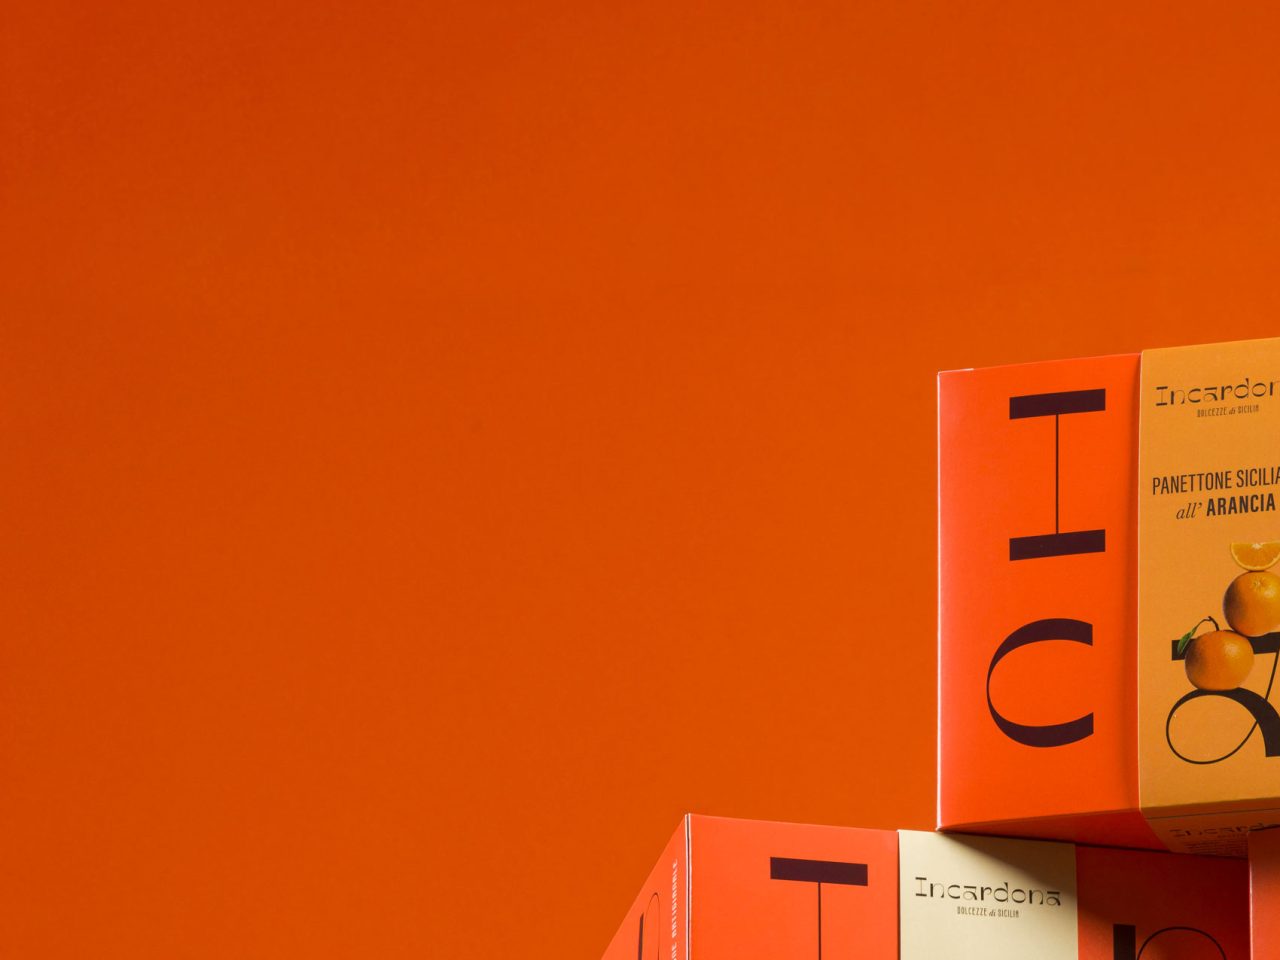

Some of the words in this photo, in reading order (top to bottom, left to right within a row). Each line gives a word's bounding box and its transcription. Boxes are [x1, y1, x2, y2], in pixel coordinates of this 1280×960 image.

[1197, 407, 1227, 417] DOLCEZZE
[1238, 404, 1259, 414] SICILIA
[1152, 471, 1232, 495] PANETTONE
[1206, 493, 1276, 516] ARANCIA
[915, 877, 1061, 906] Incardona
[957, 906, 987, 916] DOLCEZZE
[998, 910, 1019, 918] SICILIA
